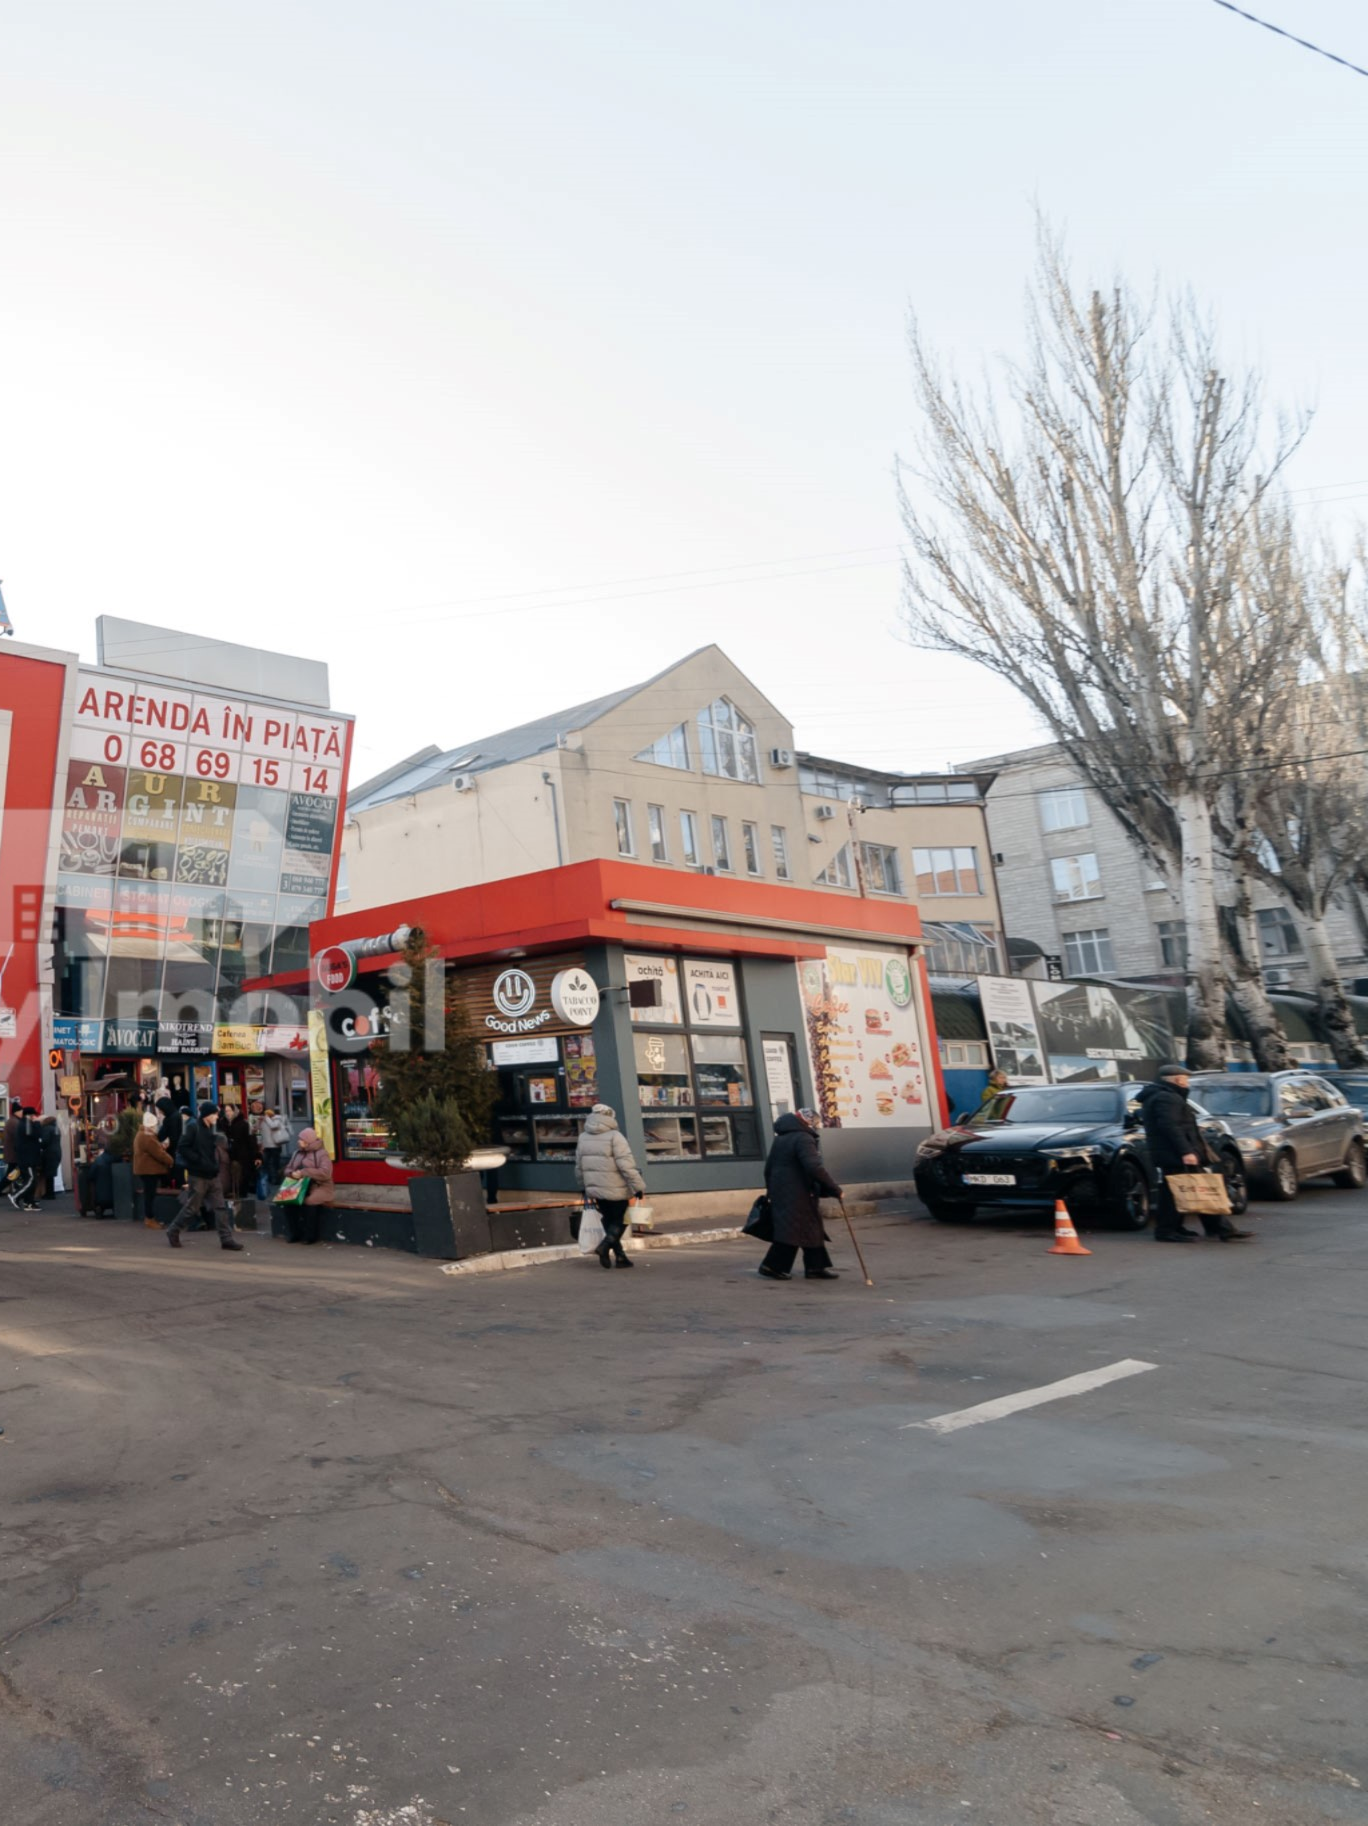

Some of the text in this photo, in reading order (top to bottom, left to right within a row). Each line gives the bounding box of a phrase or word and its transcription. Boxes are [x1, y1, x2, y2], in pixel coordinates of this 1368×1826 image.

[78, 687, 342, 761] ARENDA ÎN PIAȚĂ
[104, 734, 329, 794] 0 68 69 15 14
[292, 795, 335, 810] AVOCAT
[57, 885, 110, 900] CABINET
[326, 972, 344, 984] FOOD
[570, 1007, 592, 1016] POINT
[159, 1022, 213, 1033] NIKOTREND
[485, 1010, 552, 1032] Good News
[107, 1028, 156, 1047] AVOCAT
[216, 1030, 246, 1038] Cafenea
[171, 1038, 196, 1046] HAINE
